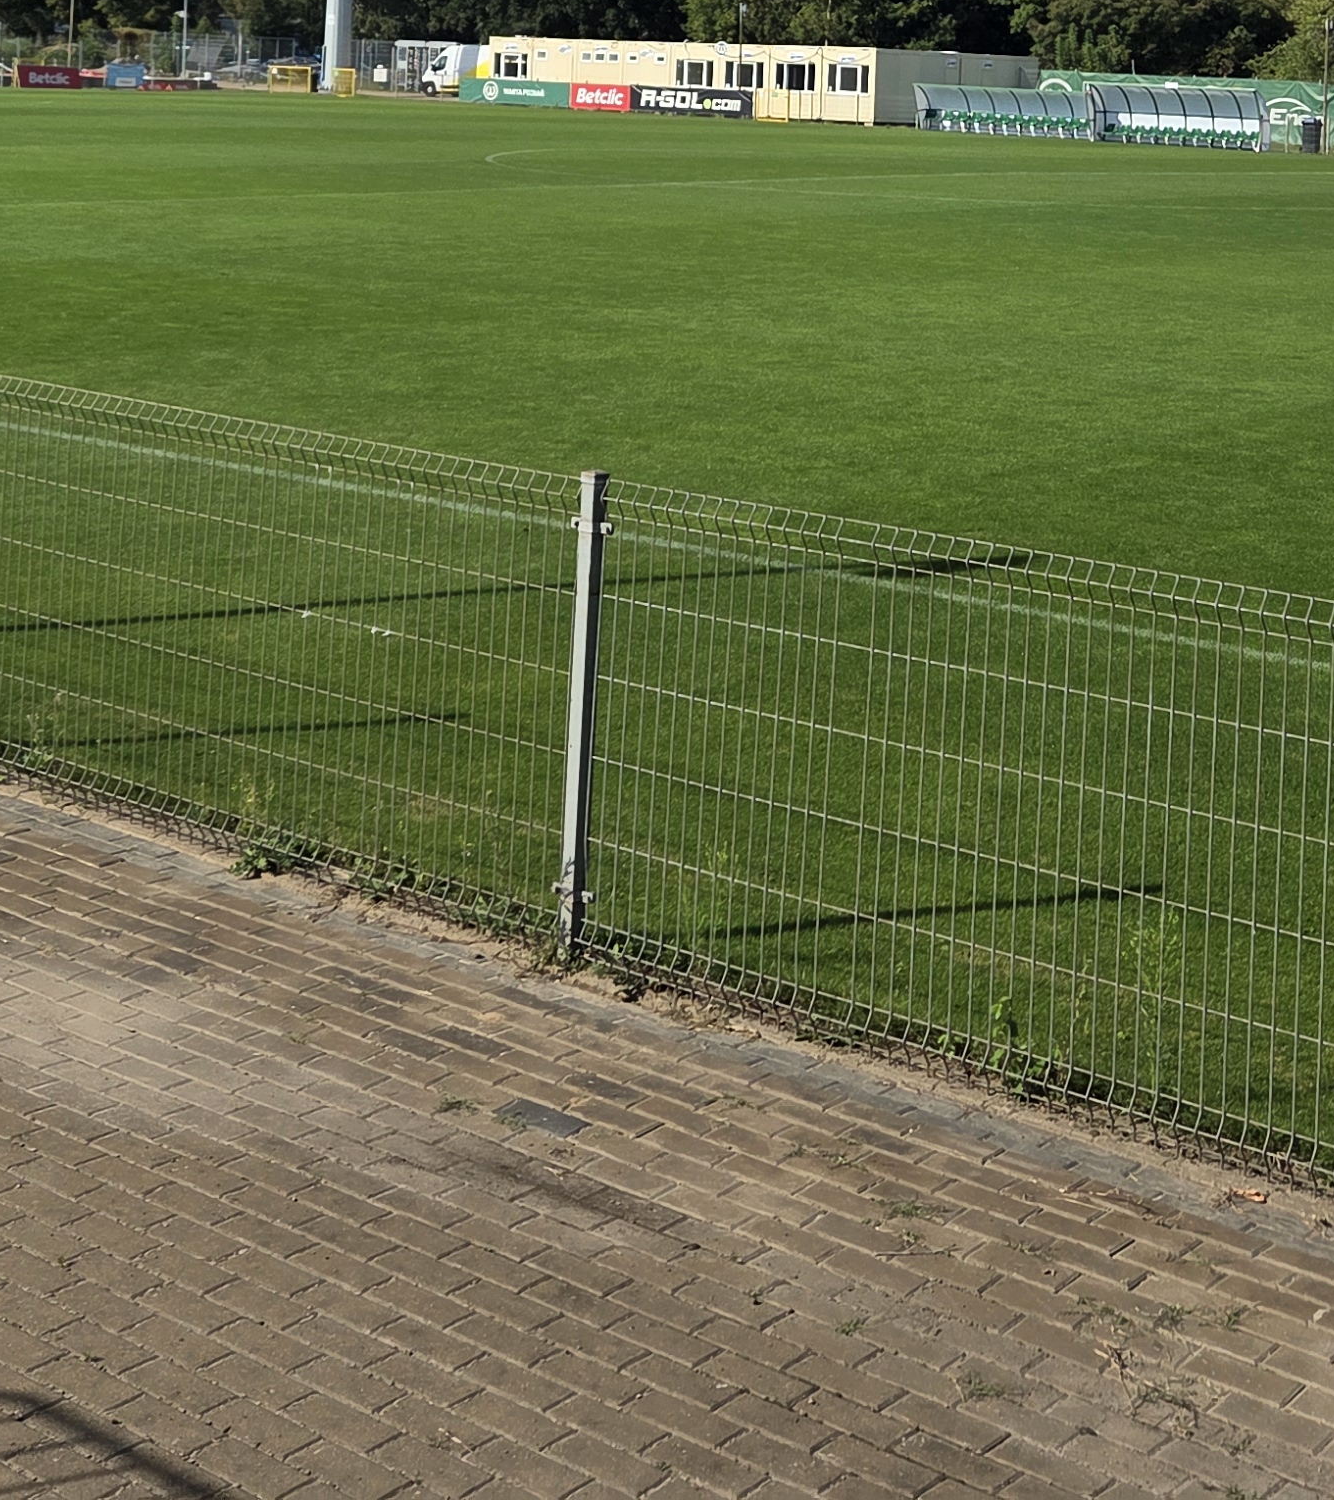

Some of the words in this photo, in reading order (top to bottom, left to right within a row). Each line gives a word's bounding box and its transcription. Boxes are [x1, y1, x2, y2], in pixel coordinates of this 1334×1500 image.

[28, 71, 70, 85] Betclic
[575, 87, 624, 106] Betclic
[640, 88, 742, 112] R-GOL.com
